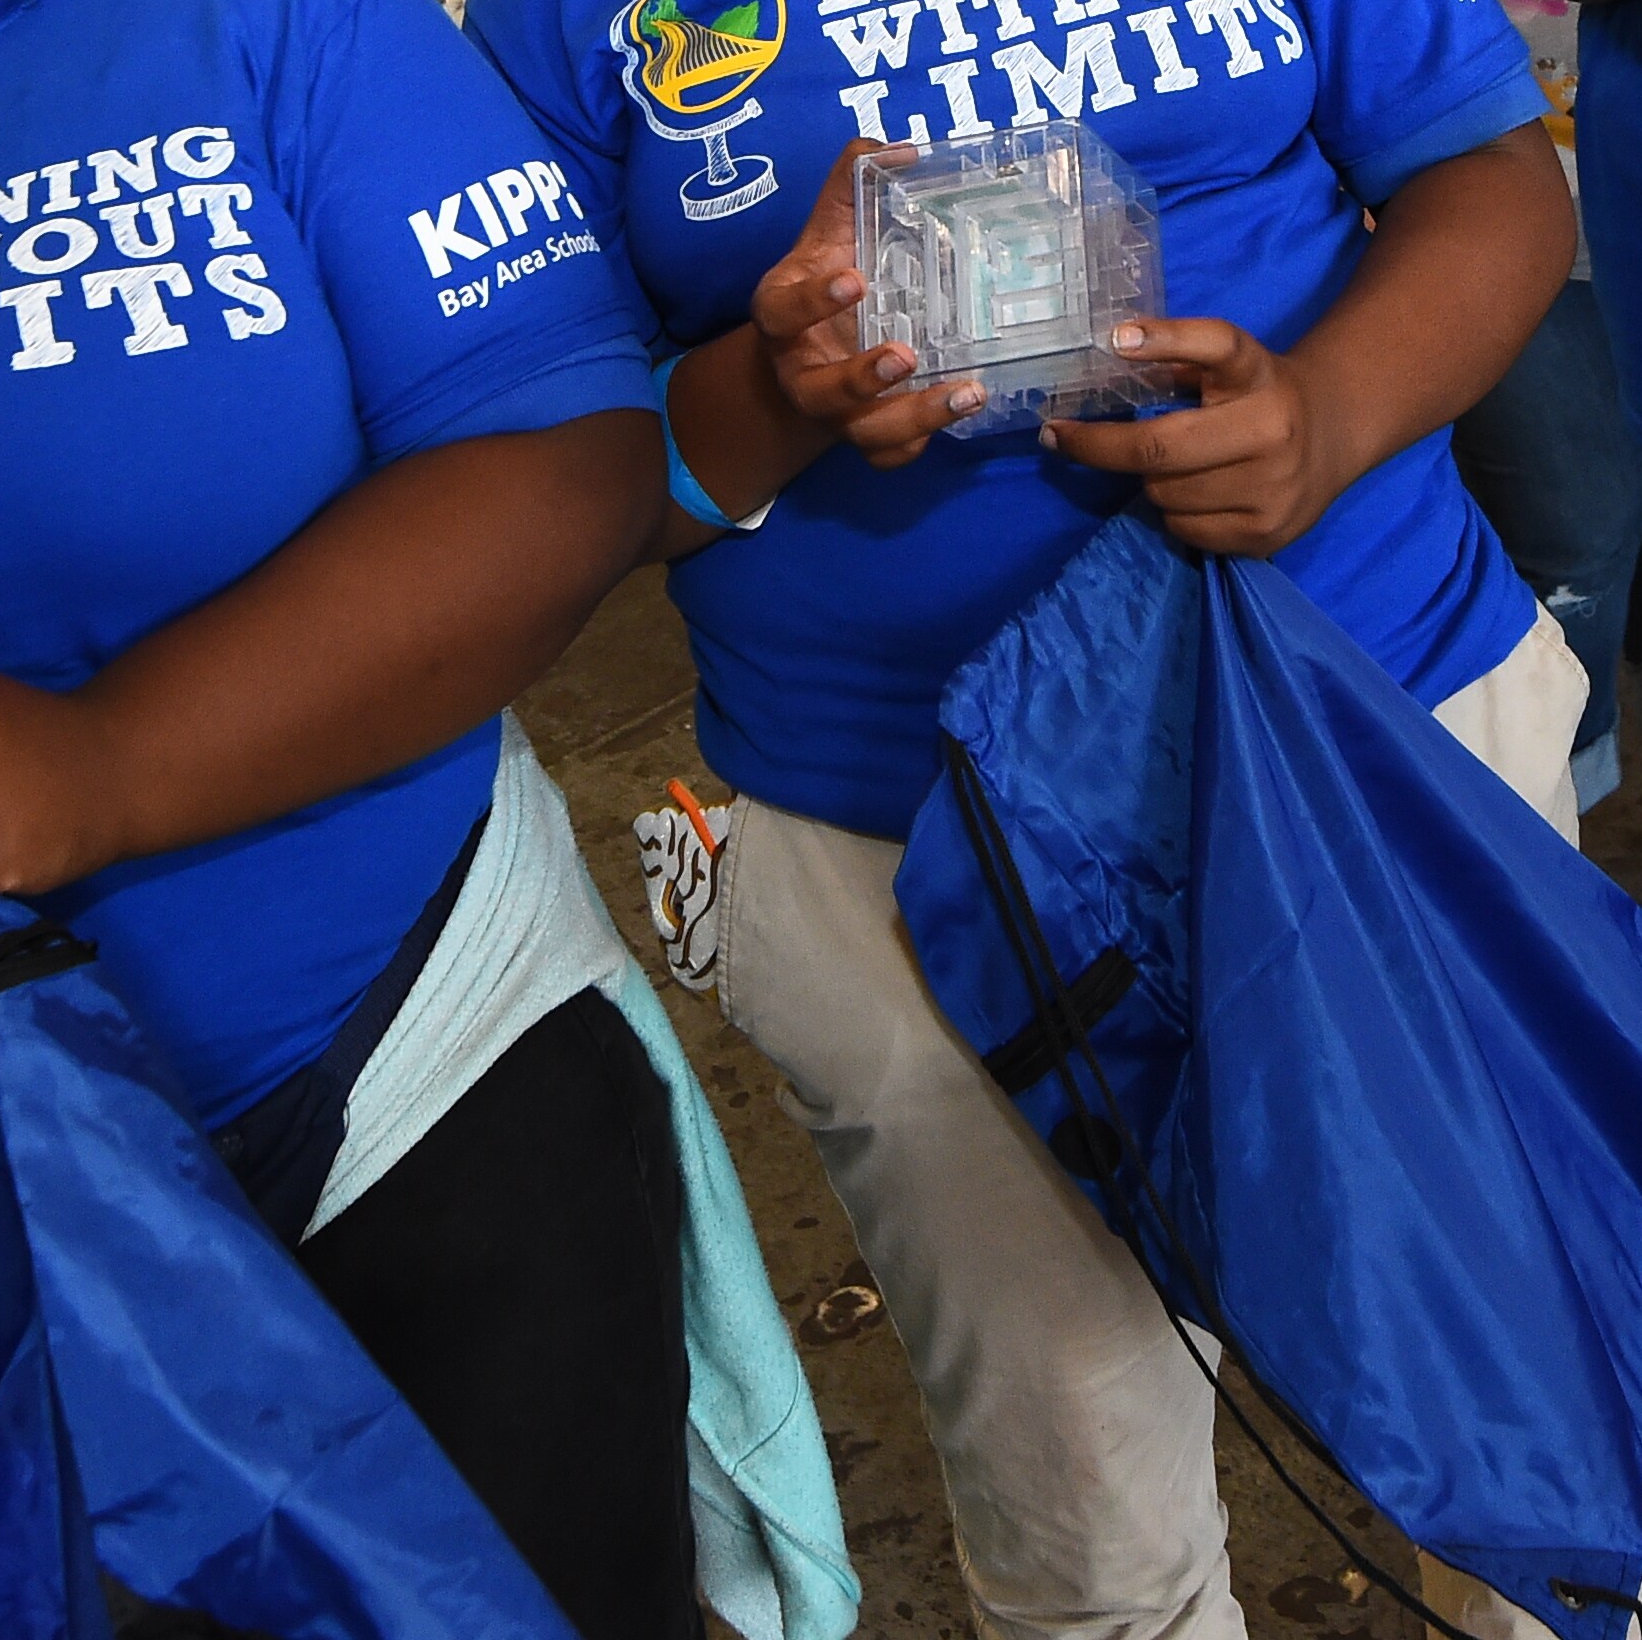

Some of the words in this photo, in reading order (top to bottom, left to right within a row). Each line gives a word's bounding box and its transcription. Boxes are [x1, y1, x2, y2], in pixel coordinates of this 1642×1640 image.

[437, 275, 489, 318] Bay
[495, 248, 547, 289] Area
[545, 228, 601, 263] Schools
